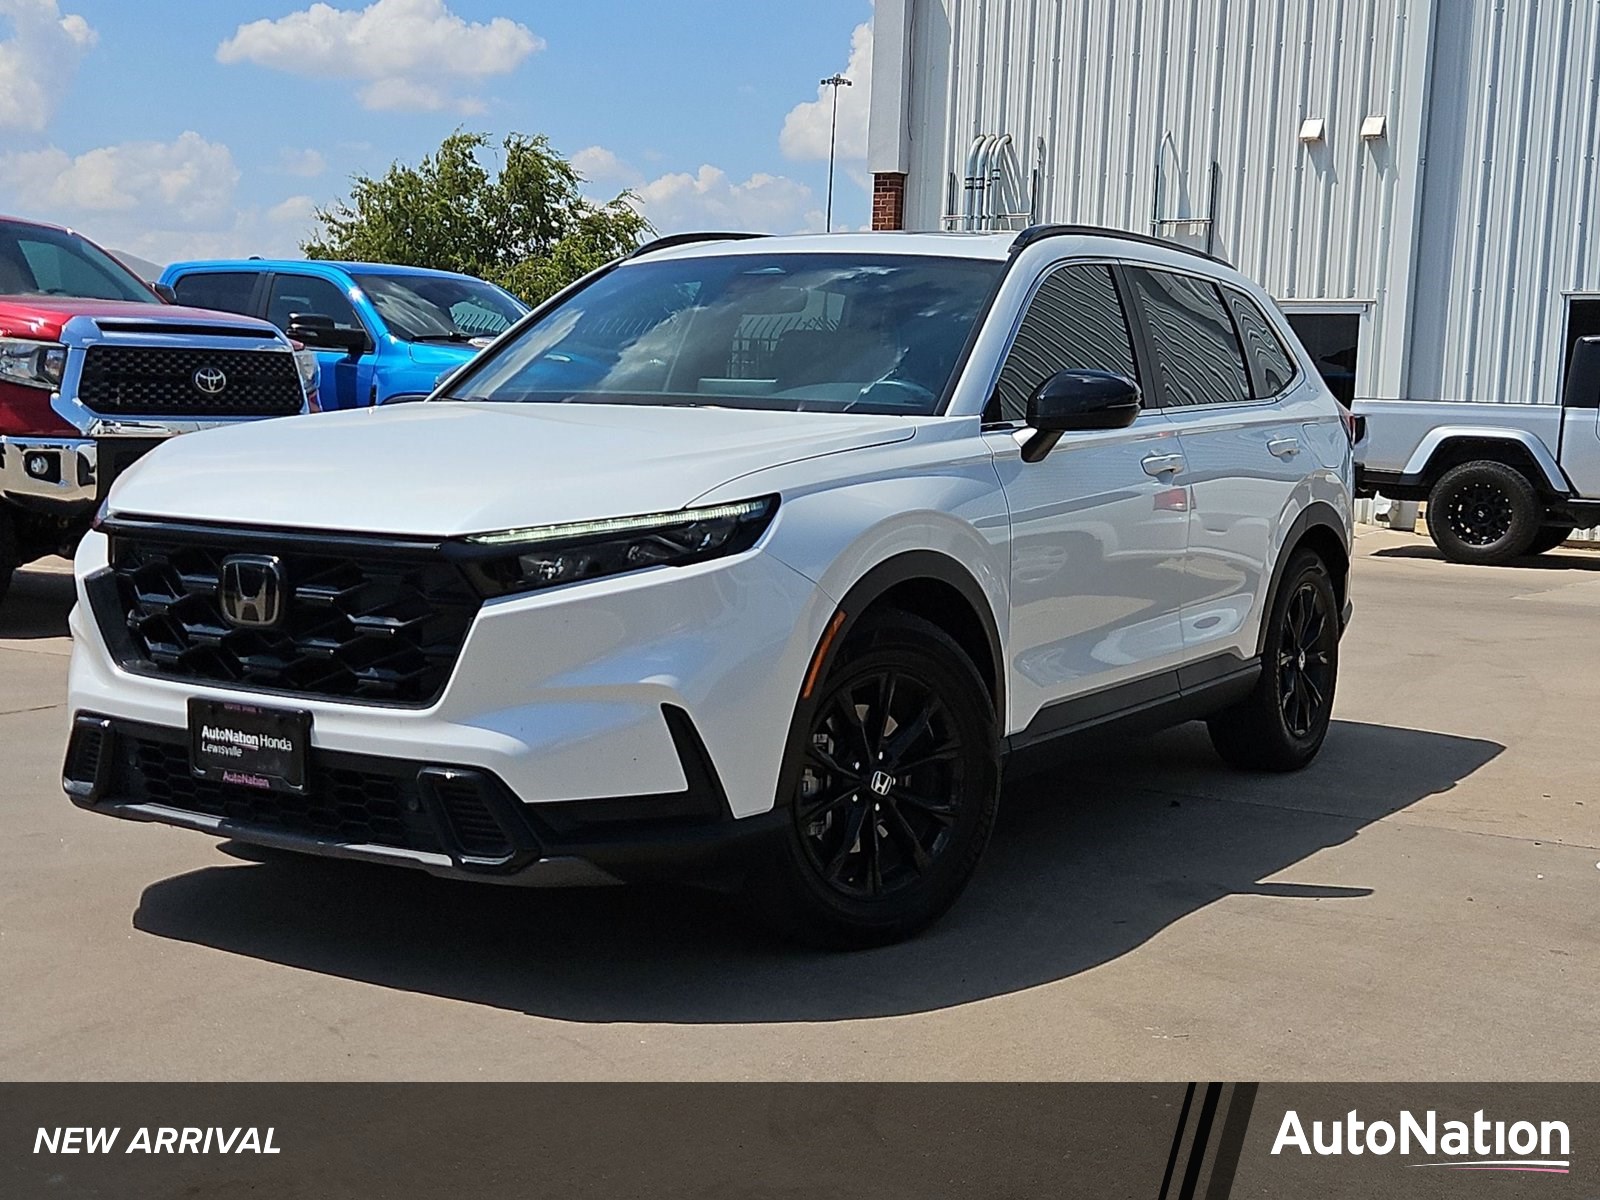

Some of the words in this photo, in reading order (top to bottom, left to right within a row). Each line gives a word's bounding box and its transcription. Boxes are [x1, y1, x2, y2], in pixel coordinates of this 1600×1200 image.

[201, 725, 259, 745] AutoNation
[260, 734, 293, 751] Honda
[201, 741, 243, 757] Lewisville
[223, 770, 270, 788] AutoNation
